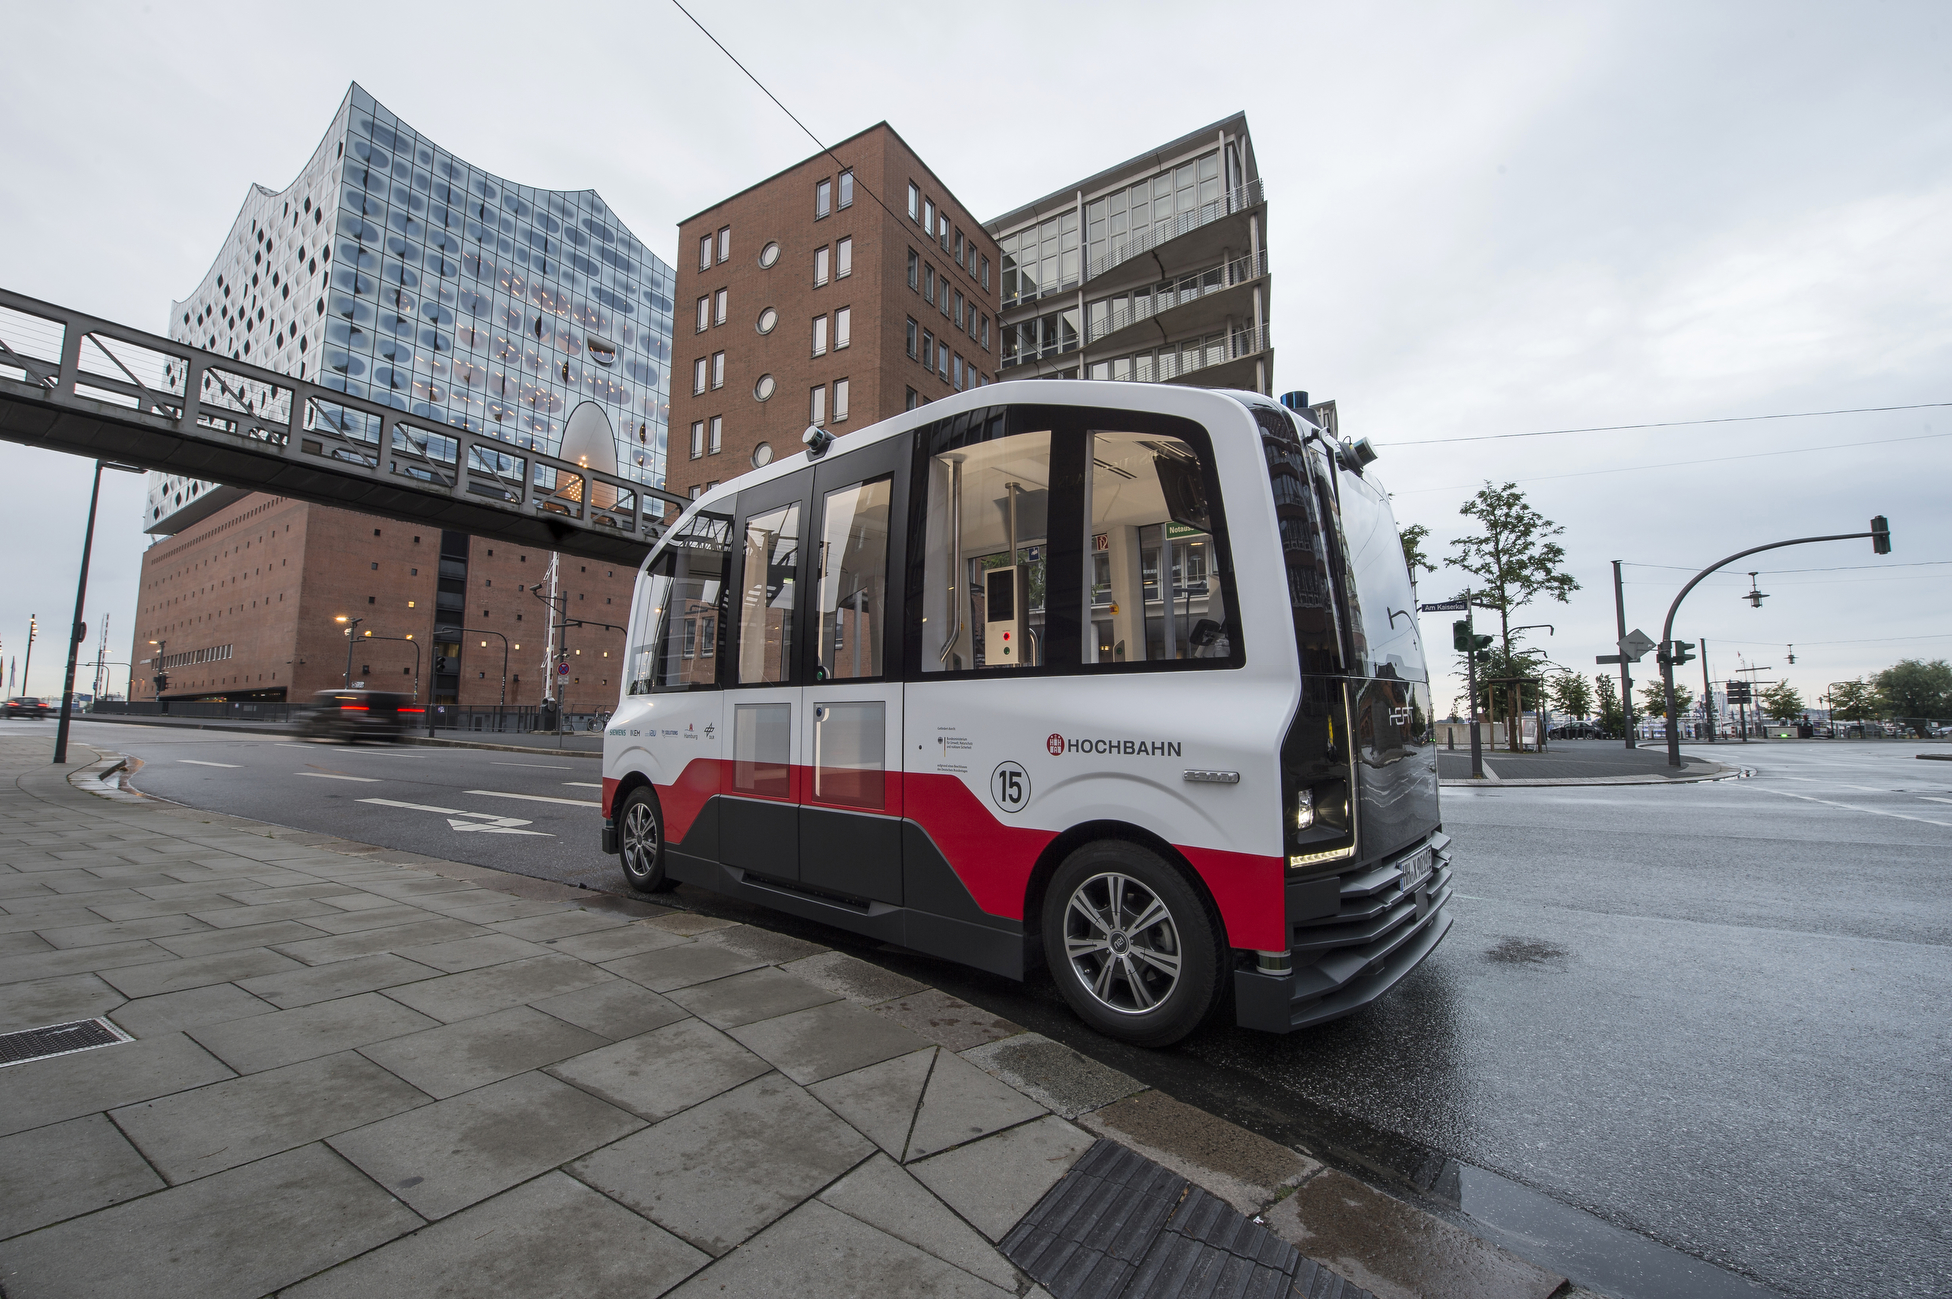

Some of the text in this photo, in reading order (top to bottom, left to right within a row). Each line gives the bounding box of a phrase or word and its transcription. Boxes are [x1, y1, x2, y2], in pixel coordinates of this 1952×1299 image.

[1436, 602, 1465, 611] Kaiserkai
[609, 729, 627, 737] SIEMENS
[1067, 738, 1182, 757] HOCHBAHN
[998, 770, 1022, 804] 15
